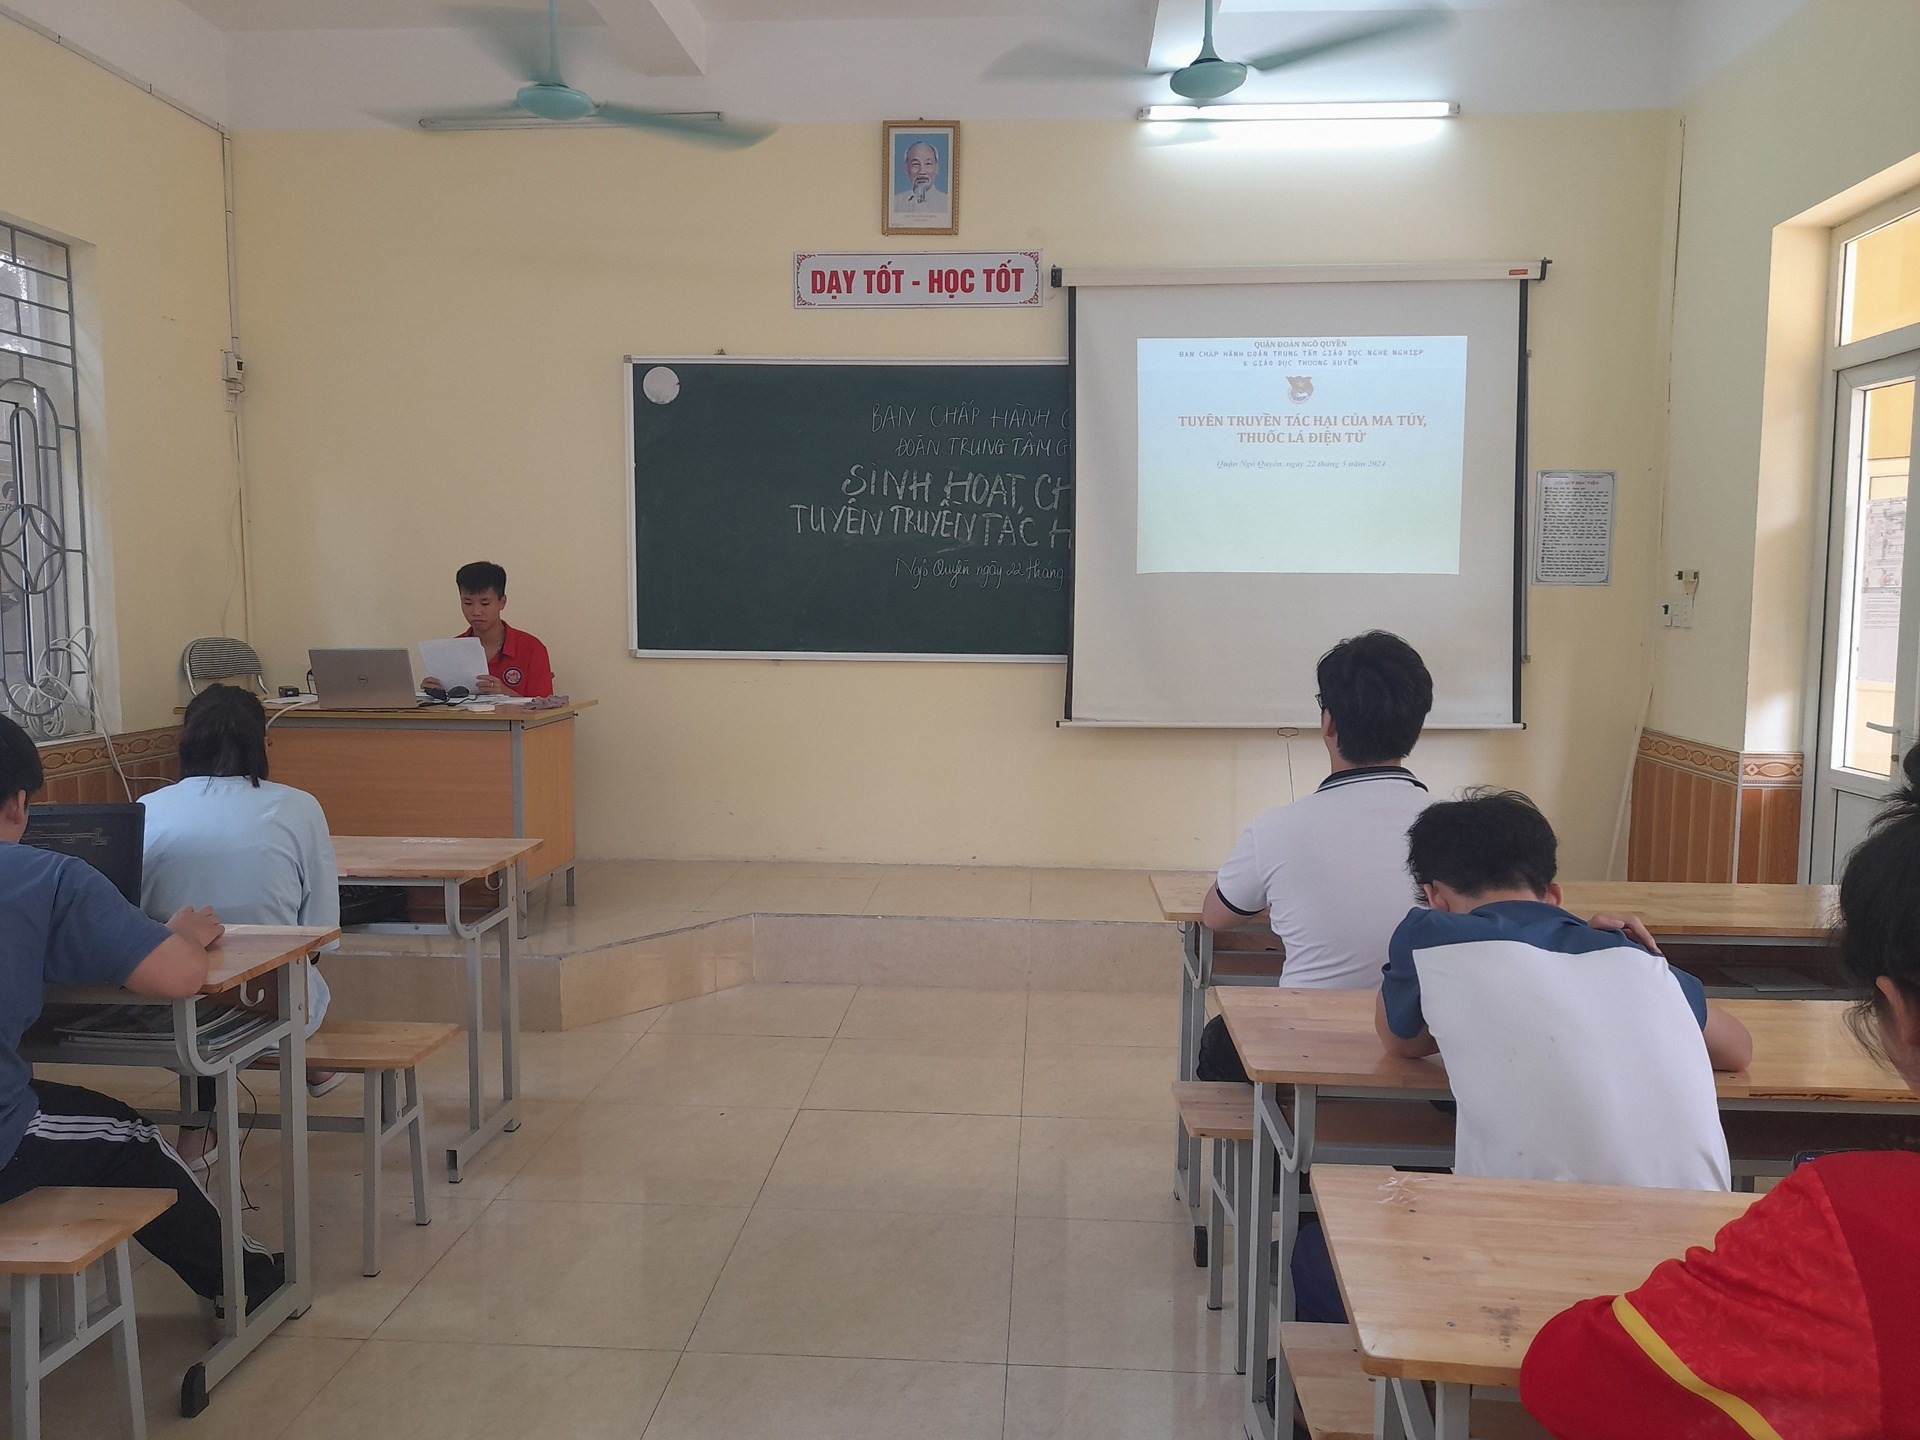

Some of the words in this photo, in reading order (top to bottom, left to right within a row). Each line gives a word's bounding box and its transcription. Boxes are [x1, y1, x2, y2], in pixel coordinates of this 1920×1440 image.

[811, 269, 856, 299] DẠY
[863, 260, 904, 294] TỐT
[928, 268, 975, 298] HỌC
[983, 259, 1024, 293] TỐT
[872, 403, 917, 432] BAN
[930, 400, 980, 428] CHẤP
[991, 403, 1051, 429] HÀNH
[1178, 413, 1224, 427] TUYÊN
[1227, 412, 1281, 427] TRUYỀN
[1285, 412, 1310, 427] TÁC
[1313, 415, 1337, 429] HẠI
[1342, 412, 1368, 427] CỦA
[1372, 415, 1393, 426] MA
[1397, 412, 1427, 428] TÚY,
[948, 437, 1007, 456] TRUNG
[1237, 430, 1284, 443] THUỐC
[1288, 430, 1305, 443] LÁ
[1308, 430, 1341, 446] ĐIỆN
[841, 462, 932, 503] SINH
[982, 505, 1039, 547] TÁC
